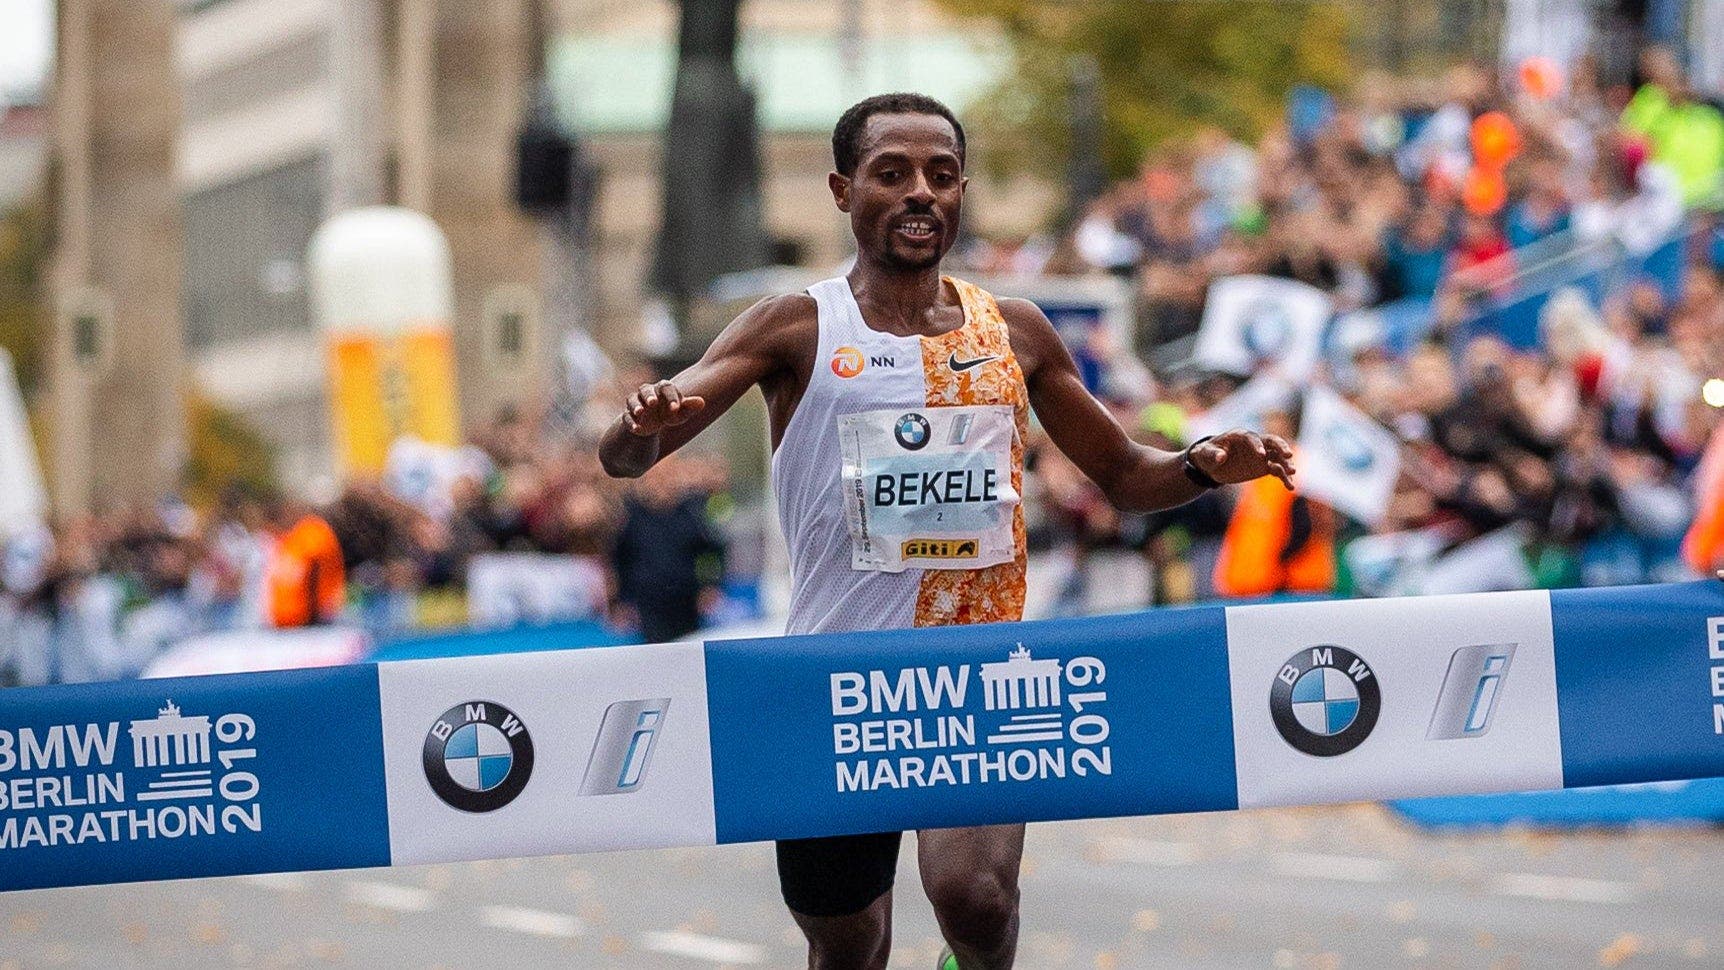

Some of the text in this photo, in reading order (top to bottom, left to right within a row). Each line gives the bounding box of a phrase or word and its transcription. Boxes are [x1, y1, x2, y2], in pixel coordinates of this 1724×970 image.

[870, 356, 895, 368] NN
[896, 414, 927, 428] BMW
[874, 468, 998, 507] BEKELE
[936, 512, 943, 522] 2
[905, 542, 948, 556] Giti
[1277, 648, 1371, 687] BMW
[830, 664, 970, 716] BMW
[433, 703, 524, 742] BMW
[833, 714, 976, 754] BERLIN
[1066, 656, 1112, 777] 2019
[215, 712, 262, 833] 2019
[836, 746, 1066, 792] MARATHON
